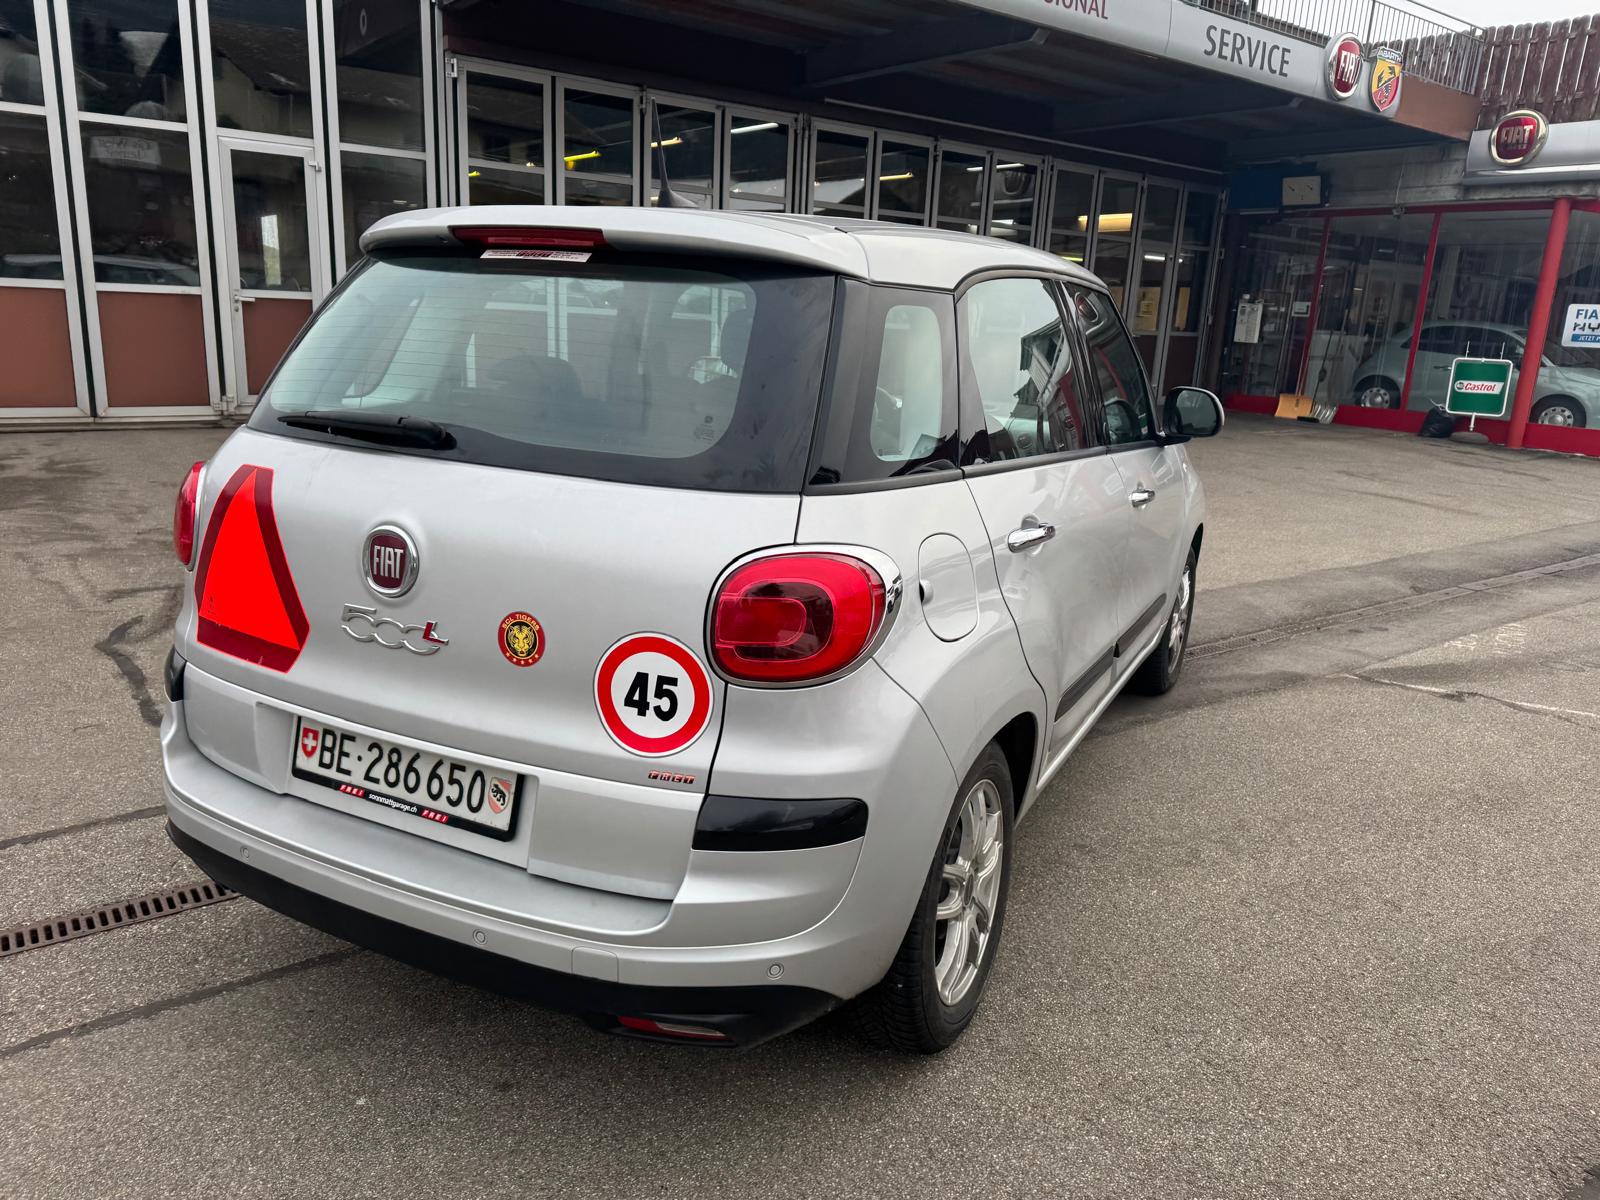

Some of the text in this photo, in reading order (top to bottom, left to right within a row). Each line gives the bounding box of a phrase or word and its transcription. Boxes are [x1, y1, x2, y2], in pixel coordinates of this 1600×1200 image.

[1203, 24, 1291, 78] SERVICE
[1464, 382, 1497, 392] Castrol
[373, 545, 404, 579] FIAT
[514, 613, 540, 631] TIGERS
[623, 671, 679, 722] 45
[368, 793, 418, 814] sonnmattgarage.ch
